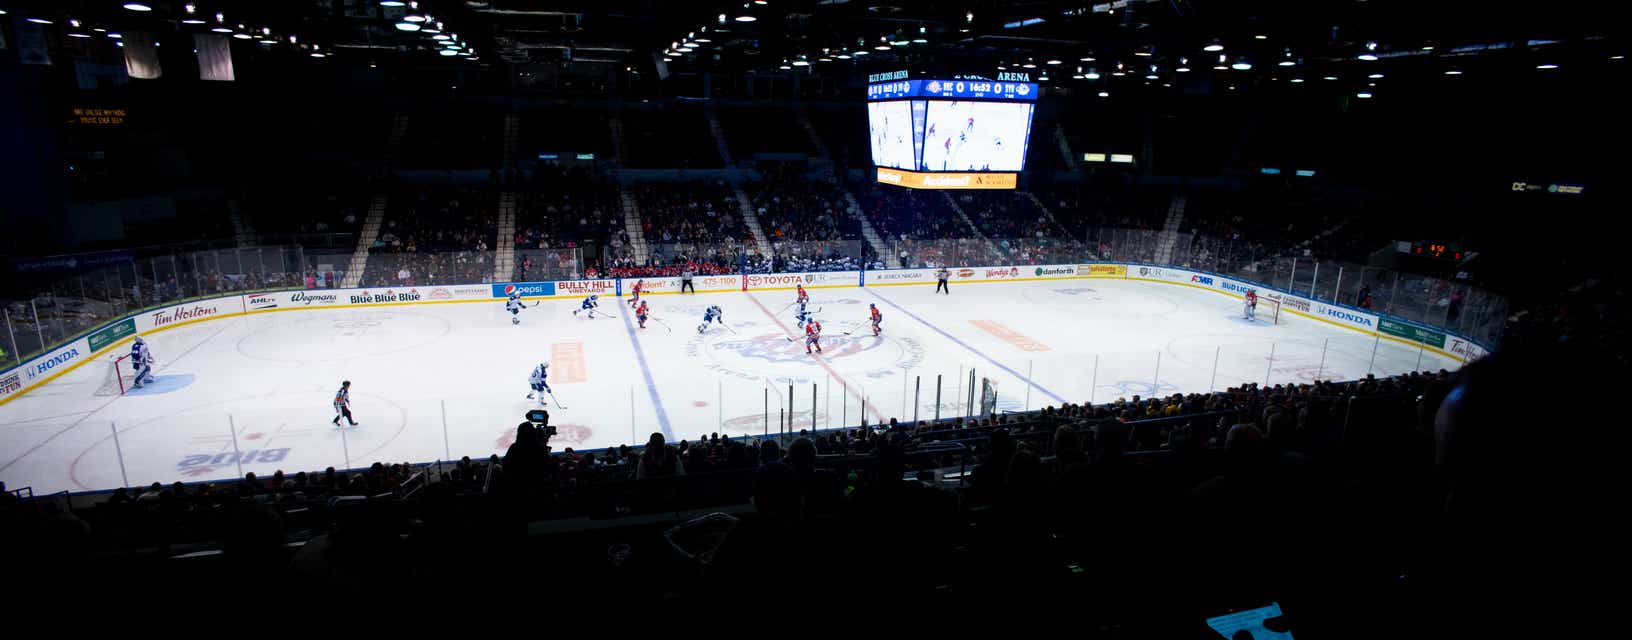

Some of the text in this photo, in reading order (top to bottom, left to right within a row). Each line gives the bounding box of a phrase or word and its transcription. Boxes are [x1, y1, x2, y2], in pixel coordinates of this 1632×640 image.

[880, 72, 893, 81] CROSS
[894, 70, 908, 80] ARENA
[997, 72, 1030, 82] ARENA
[956, 82, 965, 93] 0
[970, 83, 991, 92] 16:52
[994, 83, 1002, 94] 0
[1042, 267, 1074, 275] danforth
[559, 281, 589, 290] BULLY
[592, 280, 615, 289] HILL
[763, 275, 803, 285] TOYOTA
[518, 285, 543, 294] pepsi
[1222, 282, 1236, 291] BUD
[290, 291, 337, 305] Wegmans
[350, 293, 421, 304] Blue Blue Blue
[152, 305, 217, 326] Tim Hortons
[1328, 309, 1372, 326] HONDA
[36, 348, 80, 374] HONDA
